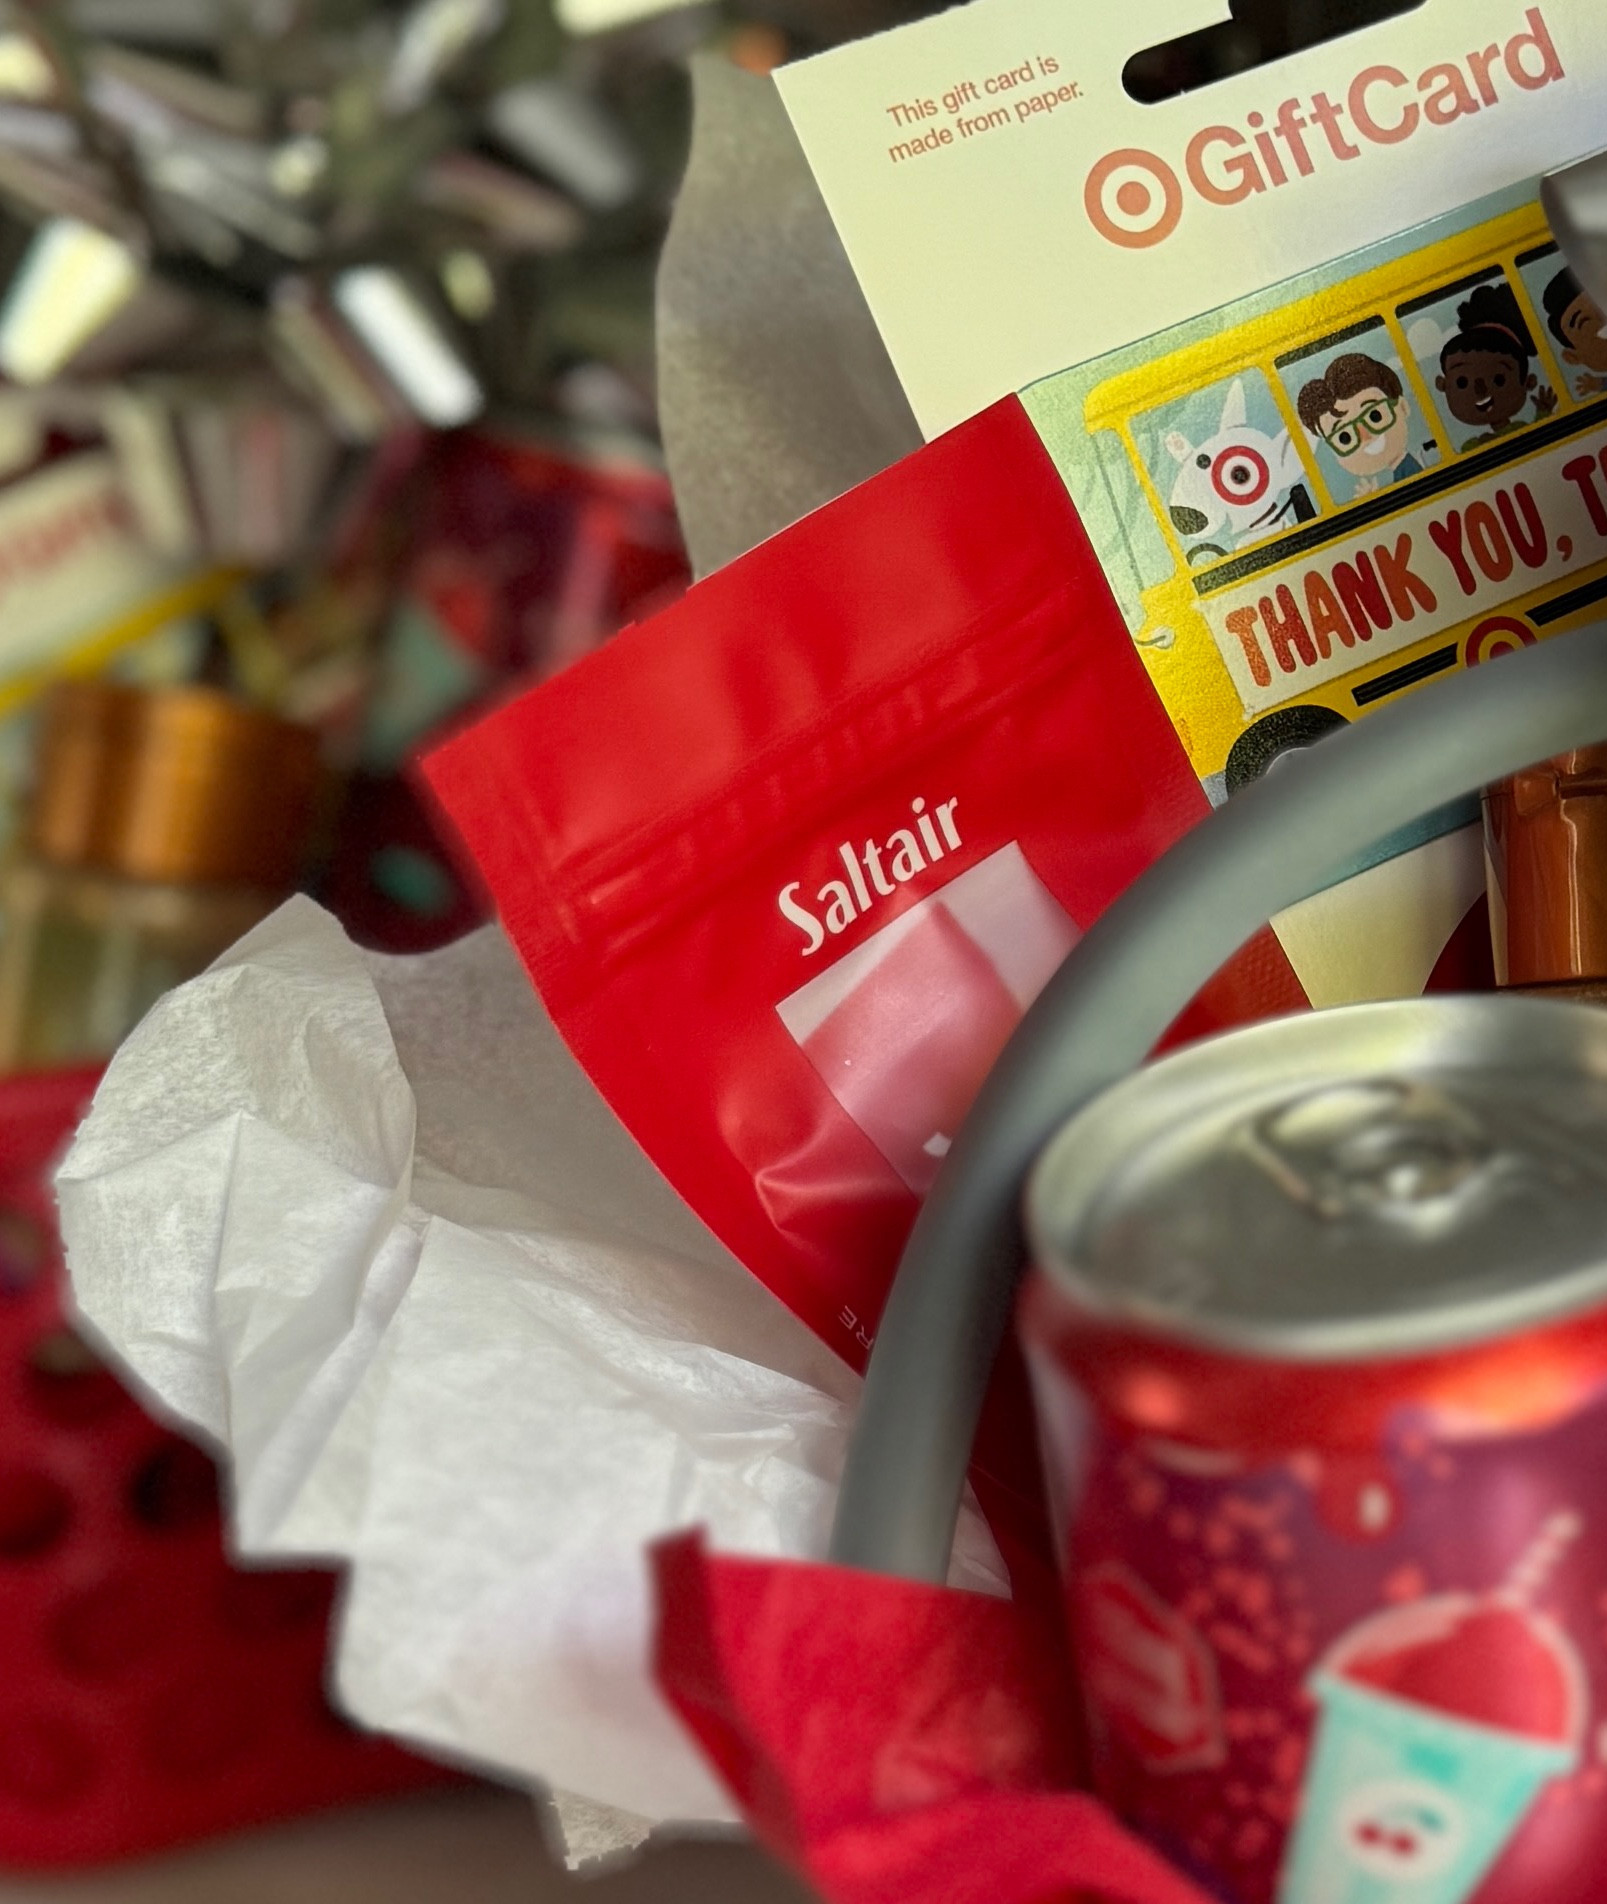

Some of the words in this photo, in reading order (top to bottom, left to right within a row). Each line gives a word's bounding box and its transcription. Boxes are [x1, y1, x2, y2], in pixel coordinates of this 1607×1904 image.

[886, 99, 938, 127] This
[942, 81, 981, 114] gift
[984, 61, 1035, 94] card
[1036, 56, 1059, 76] is
[888, 128, 954, 163] made
[956, 107, 1011, 138] from
[1014, 81, 1084, 123] paper.
[1185, 7, 1566, 206] GiftCard
[1224, 533, 1438, 688] THANK
[1427, 482, 1573, 597] YOU,
[778, 797, 962, 956] Saltair
